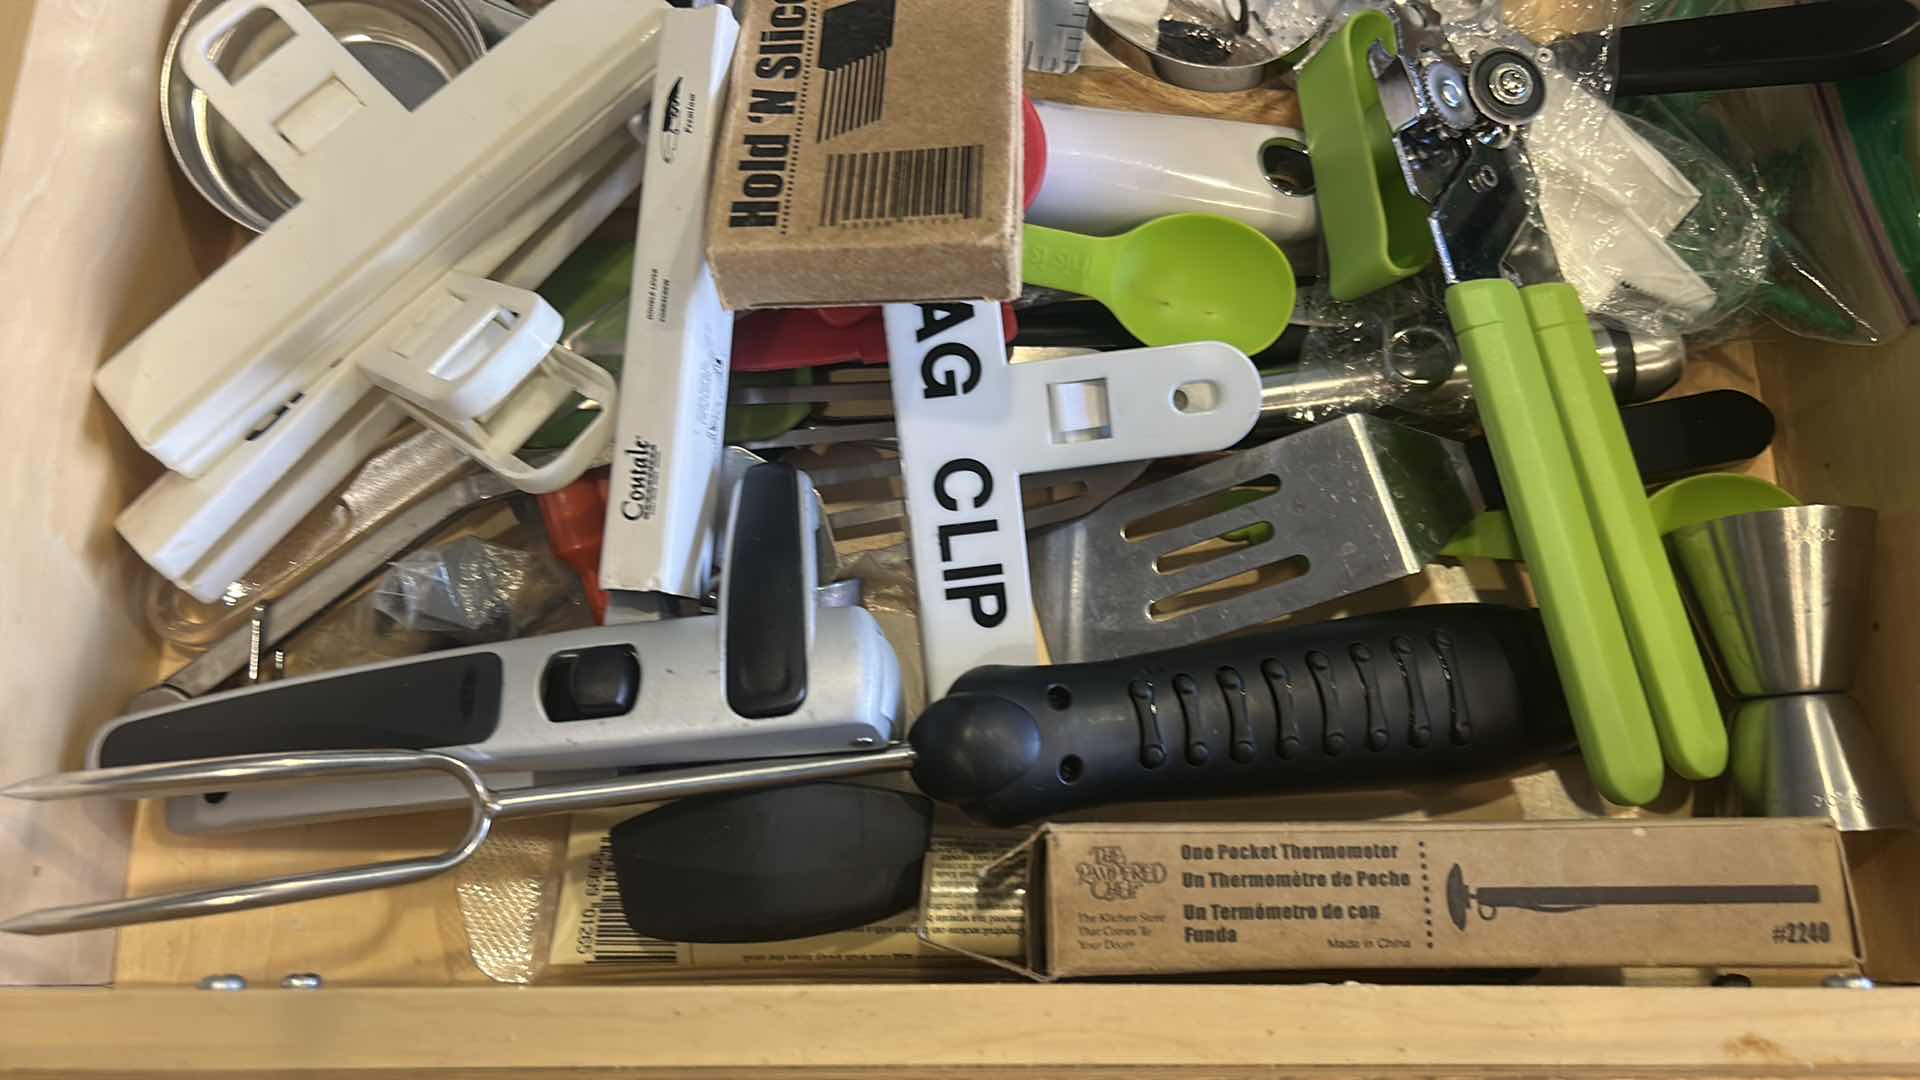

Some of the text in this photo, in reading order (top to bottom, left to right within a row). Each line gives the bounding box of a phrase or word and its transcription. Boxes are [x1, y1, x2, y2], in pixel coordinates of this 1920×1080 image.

[755, 0, 807, 79] Slic
[728, 134, 790, 228] Hold
[916, 302, 1007, 628] AG CLIP
[1181, 843, 1399, 860] One Pocket Thermometer
[1182, 870, 1411, 888] Un Thermomètre de Poche
[1183, 903, 1381, 920] Un Termómetro de con
[1184, 926, 1238, 943] Funda
[1771, 921, 1832, 944] #2240
[1328, 937, 1412, 949] Made in China
